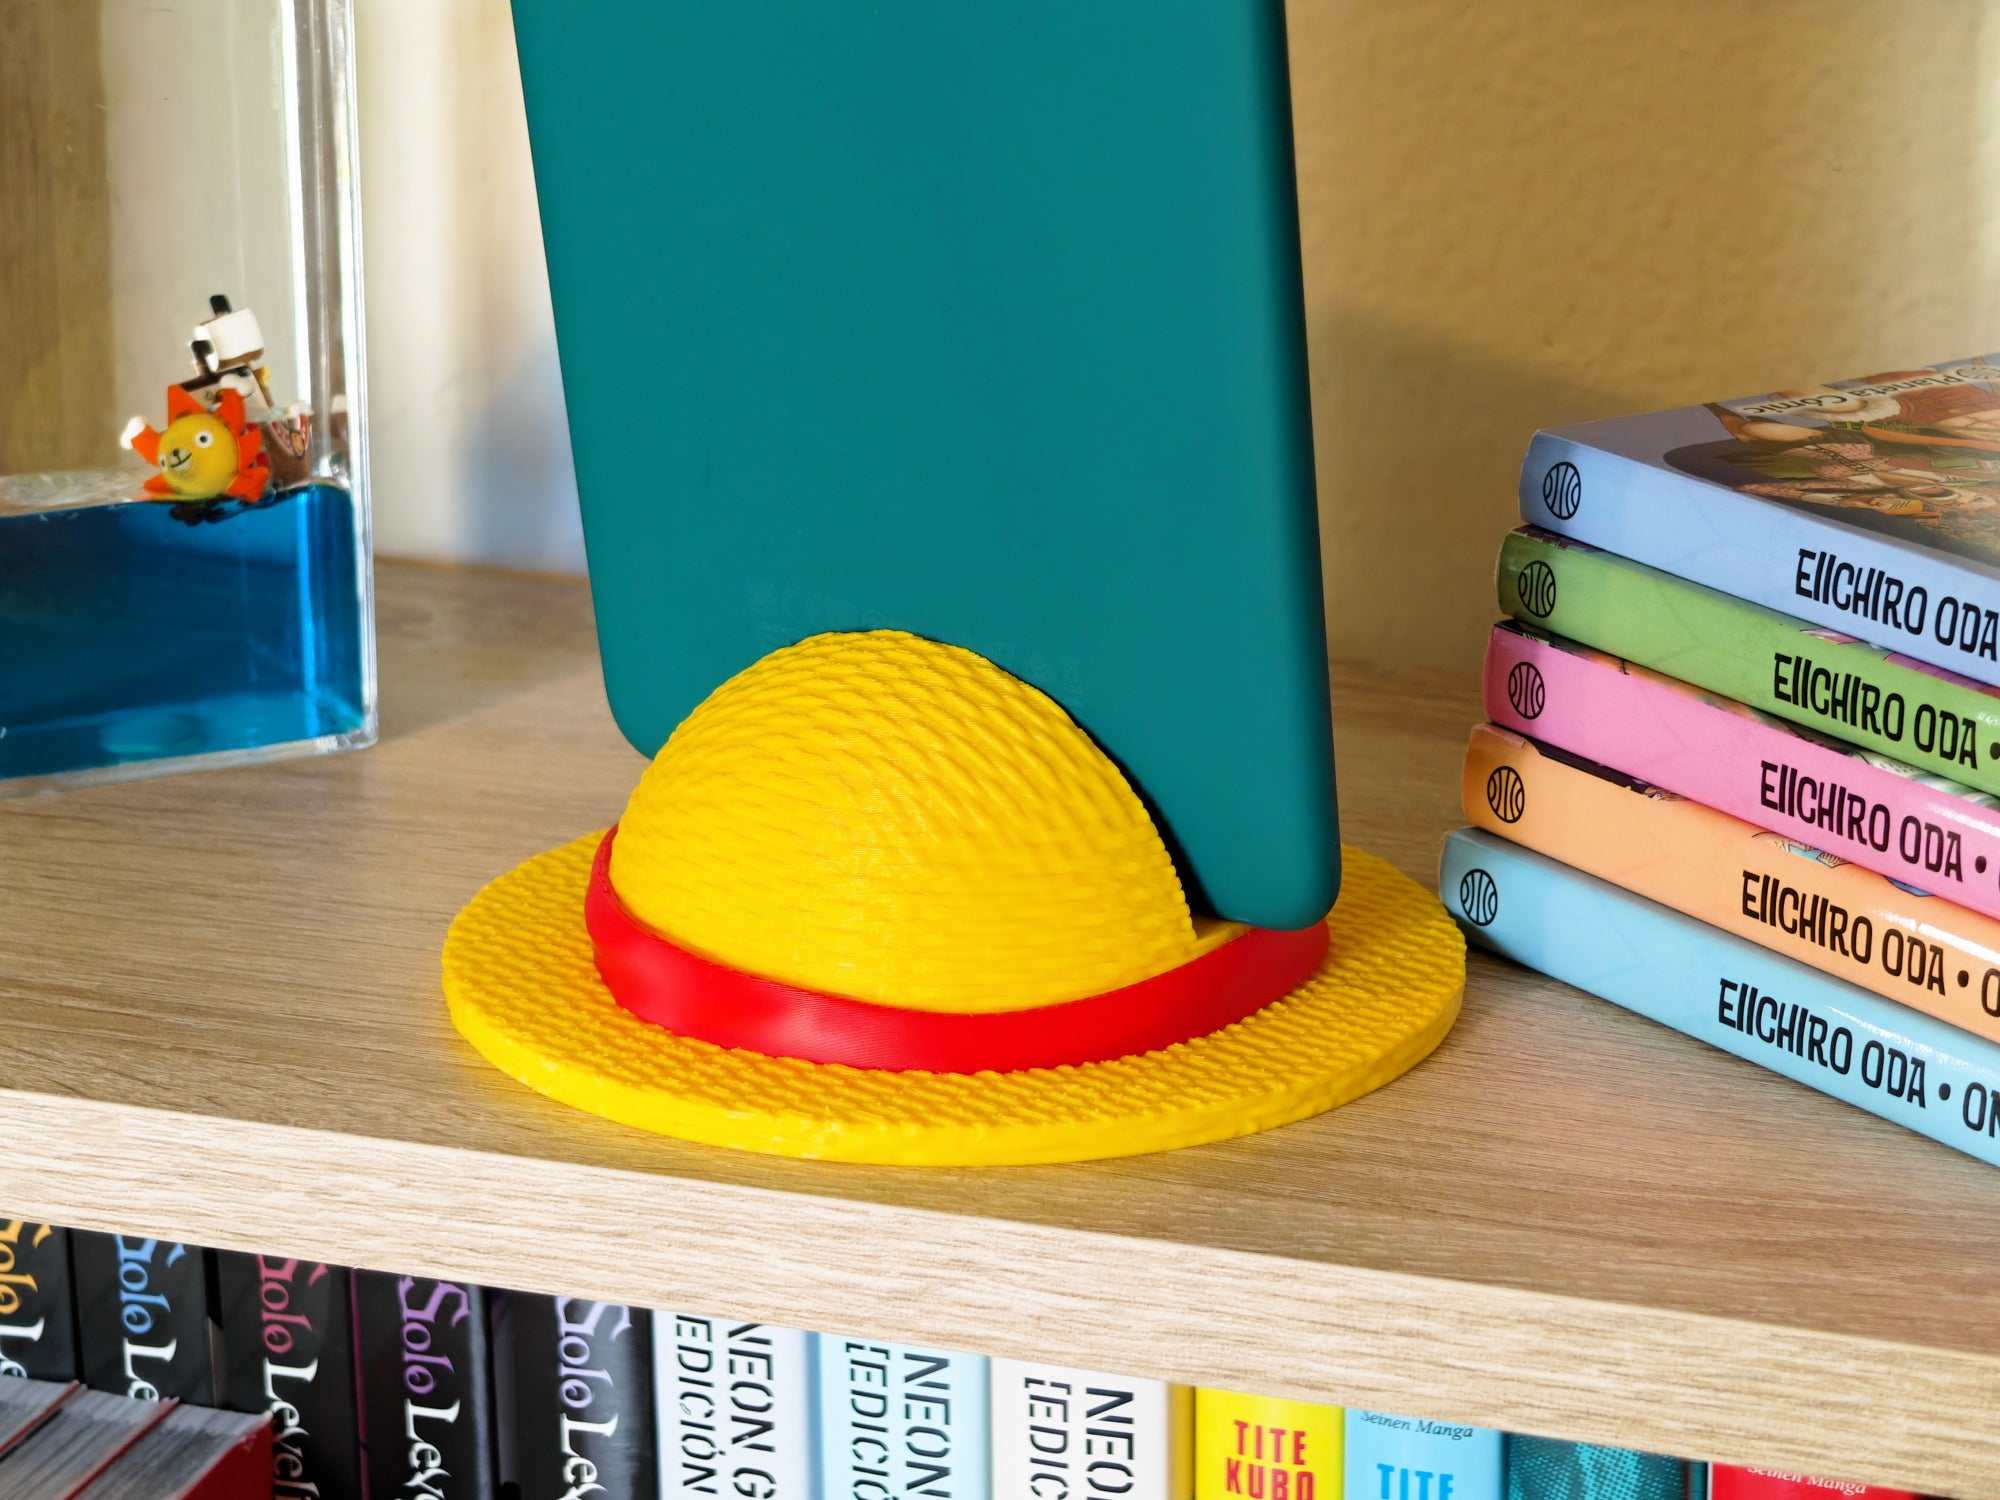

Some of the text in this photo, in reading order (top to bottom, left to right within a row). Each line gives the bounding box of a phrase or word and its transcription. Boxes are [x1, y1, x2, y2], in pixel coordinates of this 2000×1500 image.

[1743, 374, 1963, 415] Planeta Cómic
[1795, 548, 2000, 662] EIICHIRO ODA
[1774, 652, 1979, 770] EIICHIRO ODA
[1760, 760, 1964, 883] EIICHIRO ODA
[1742, 870, 1873, 965] EIICHIRO
[1881, 928, 1947, 996] ODA
[1718, 978, 1853, 1075] EIICHIRO
[1861, 1039, 1927, 1109] ODA
[397, 1276, 471, 1394] Solo
[555, 1296, 632, 1409] Solo
[904, 1352, 951, 1499] NEON
[1085, 1386, 1135, 1500] NEO
[1225, 1457, 1315, 1500] KUBO
[1233, 1419, 1307, 1466] TITE
[1360, 1409, 1474, 1441] Seinen Manga
[1376, 1462, 1454, 1500] TITE
[1806, 1475, 1868, 1496] Manga
